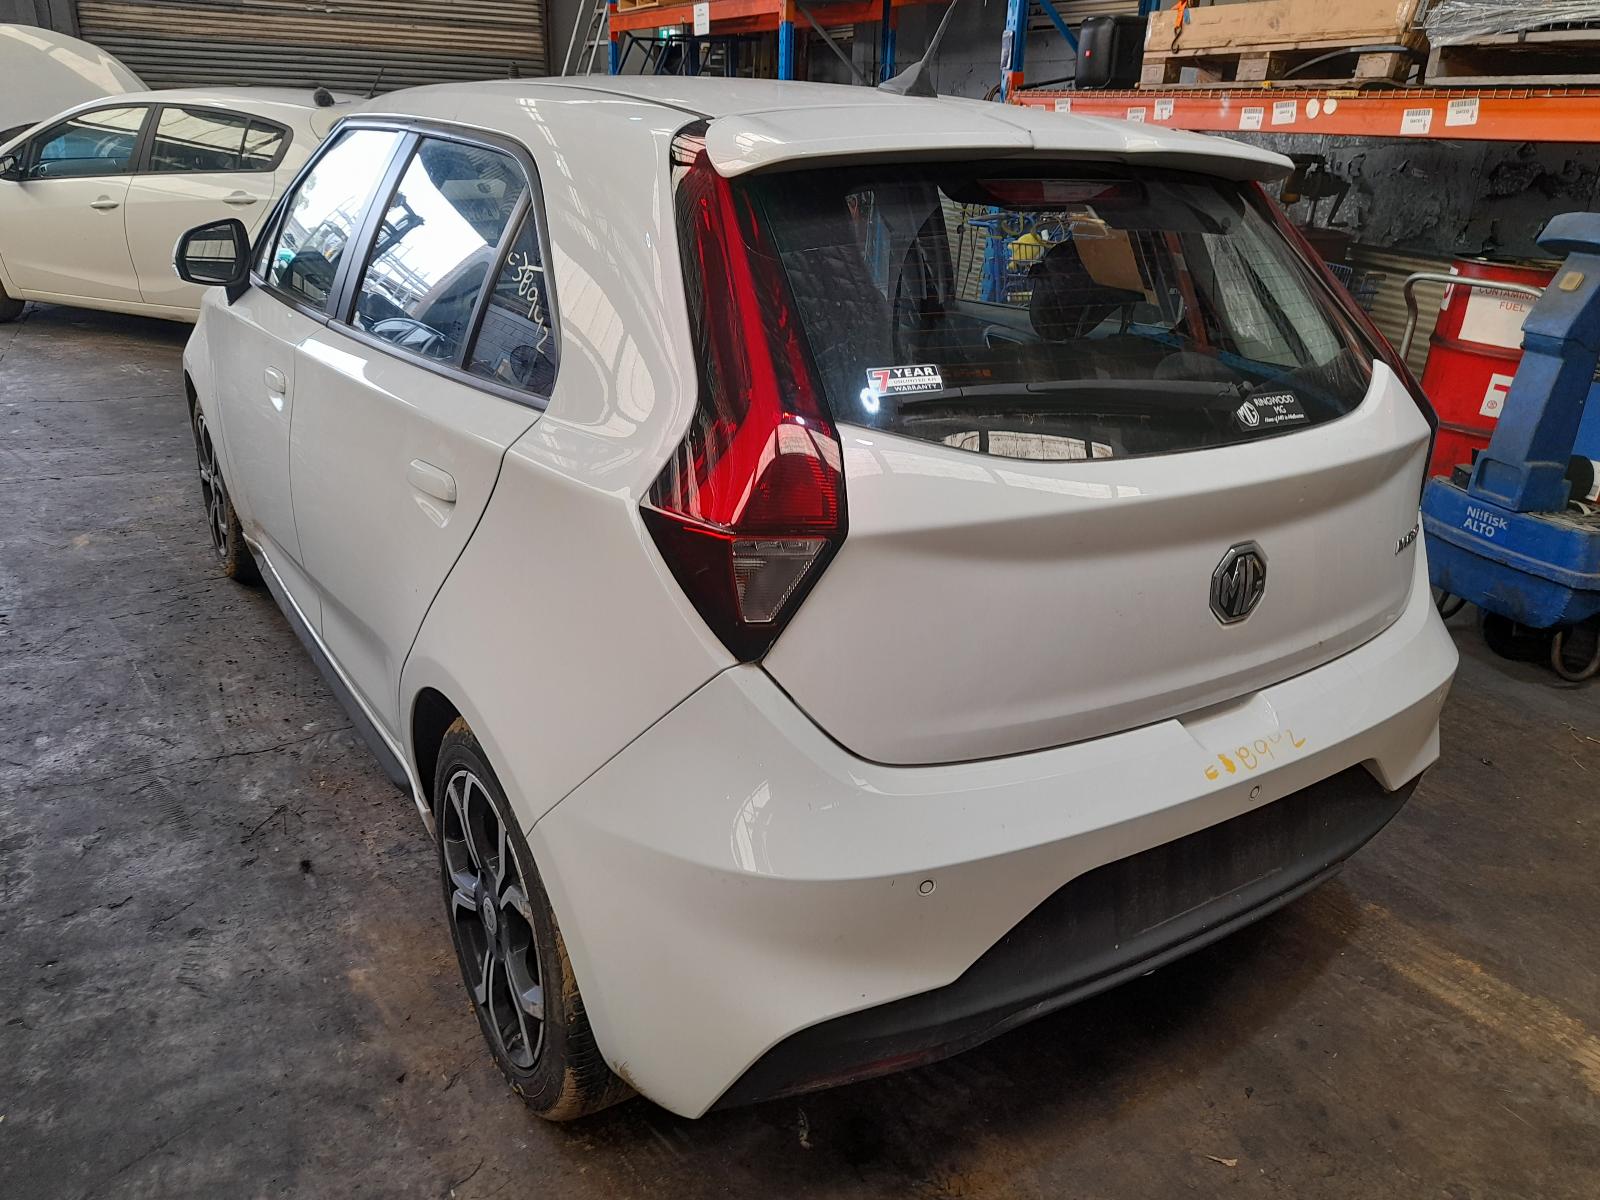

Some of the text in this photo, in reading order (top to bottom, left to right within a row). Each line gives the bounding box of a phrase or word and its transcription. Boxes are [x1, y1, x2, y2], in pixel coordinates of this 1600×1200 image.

[1499, 301, 1525, 313] FUEL
[894, 366, 935, 378] YEAR
[872, 369, 890, 393] 7
[894, 383, 937, 392] WARRANTY
[1253, 394, 1295, 407] RINGWOOD
[1236, 401, 1260, 427] MG
[1273, 404, 1287, 415] MG
[1466, 505, 1508, 531] Nilfisk
[1463, 518, 1495, 538] ALTO
[1216, 549, 1264, 618] MG
